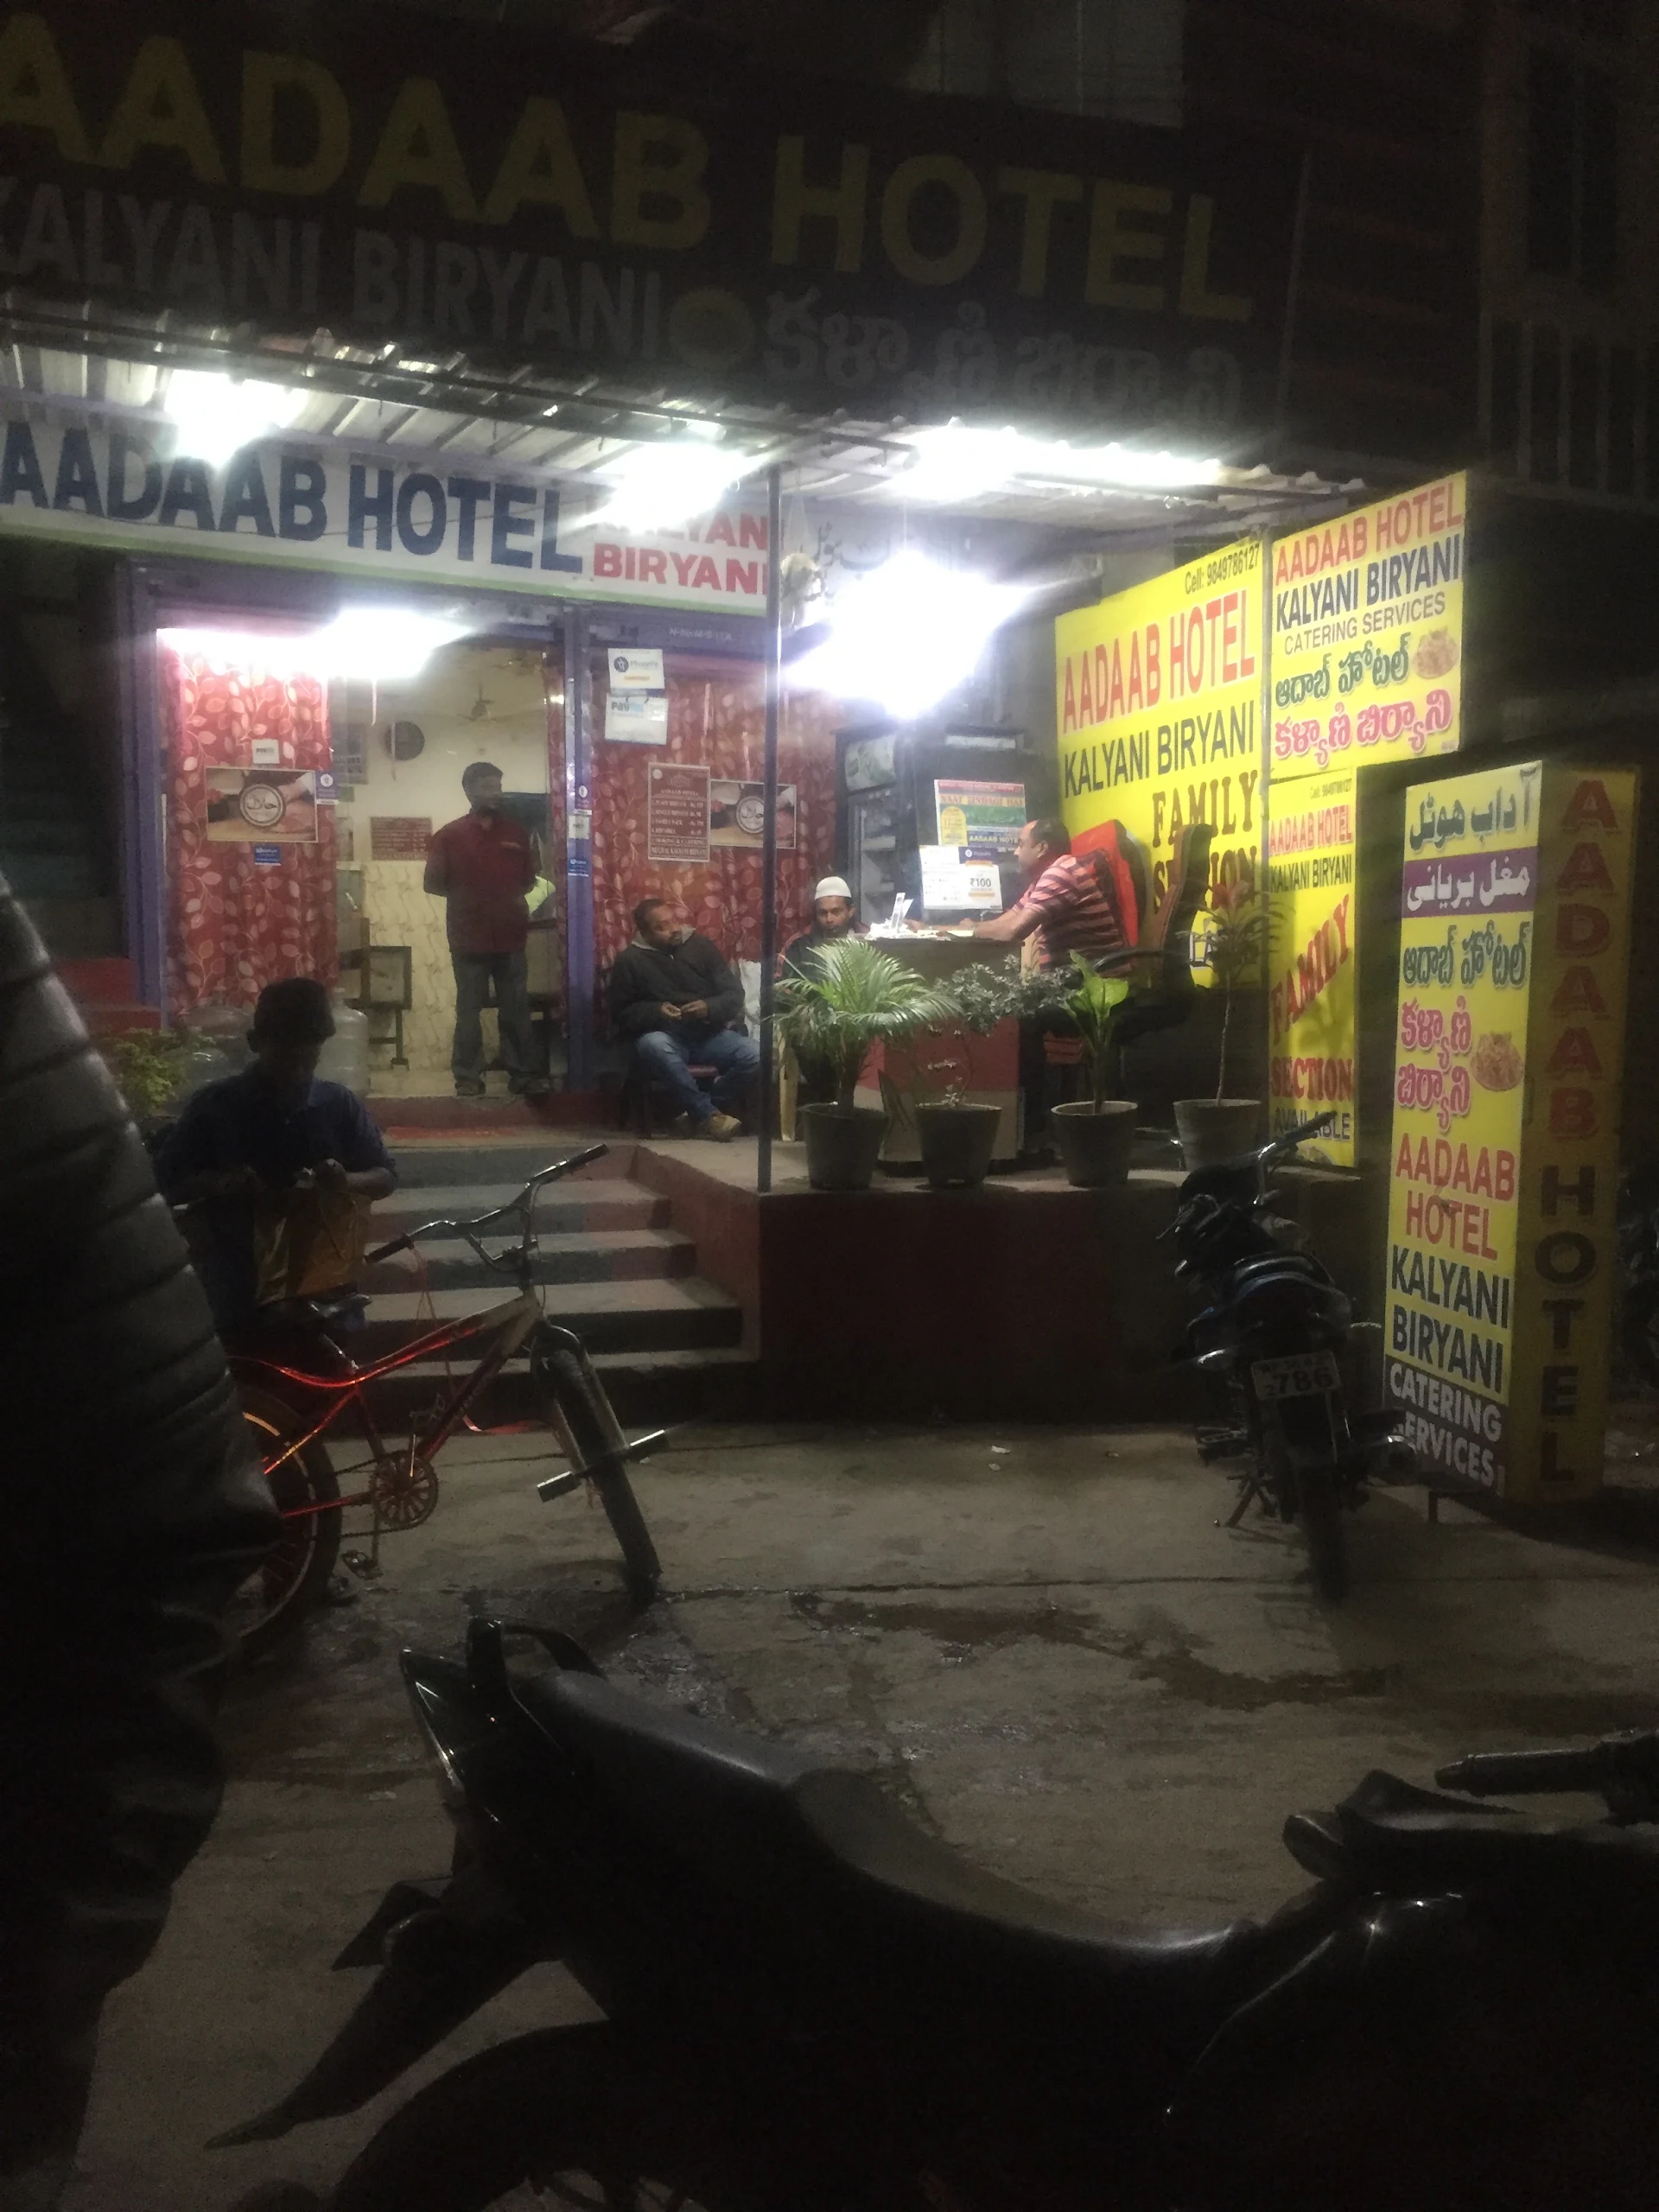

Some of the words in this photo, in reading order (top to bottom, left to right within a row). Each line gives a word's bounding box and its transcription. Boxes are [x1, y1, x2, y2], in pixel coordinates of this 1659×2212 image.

[0, 12, 711, 251] AADAAB
[772, 133, 1253, 323] HOTEL
[353, 227, 661, 360] BIRYANI
[0, 420, 328, 542] AADAAB
[347, 464, 583, 575] HOTEL
[1275, 516, 1368, 586] AADAAB
[1376, 481, 1463, 552] HOTEL
[1207, 543, 1261, 587] 9849786127
[1276, 569, 1359, 632] KALYANI
[1366, 533, 1461, 606] BIRYANI
[1063, 622, 1161, 734] AADAAB
[1169, 589, 1255, 701] HOTEL
[1284, 617, 1357, 656] CATERING
[1363, 591, 1446, 635] SERVICES
[1275, 652, 1332, 709] ఆదాబ్
[1338, 632, 1412, 695] హోటల్
[1065, 729, 1150, 797] KALYANI
[1157, 700, 1255, 775] BIRYANI
[1152, 769, 1258, 848] FAMILY
[1268, 821, 1315, 855] AADAAB
[1318, 804, 1353, 846] HOTEL
[969, 877, 992, 888] ₹100
[1270, 862, 1310, 894] KALYANI
[1312, 853, 1352, 890] BIRYANI
[1478, 855, 1531, 907] مغل
[1271, 893, 1351, 1046] FAMILY
[1545, 779, 1621, 1139] AADAAB
[1270, 1057, 1354, 1102] SECTION
[1395, 1132, 1516, 1202] AADAAB
[1405, 1190, 1498, 1261] HOTEL
[1391, 1243, 1510, 1330] KALYANI
[1534, 1165, 1598, 1484] HOTEL
[1392, 1303, 1503, 1395] BIRYANI
[1389, 1363, 1503, 1443] CATERING
[1393, 1410, 1495, 1488] ERVICES
